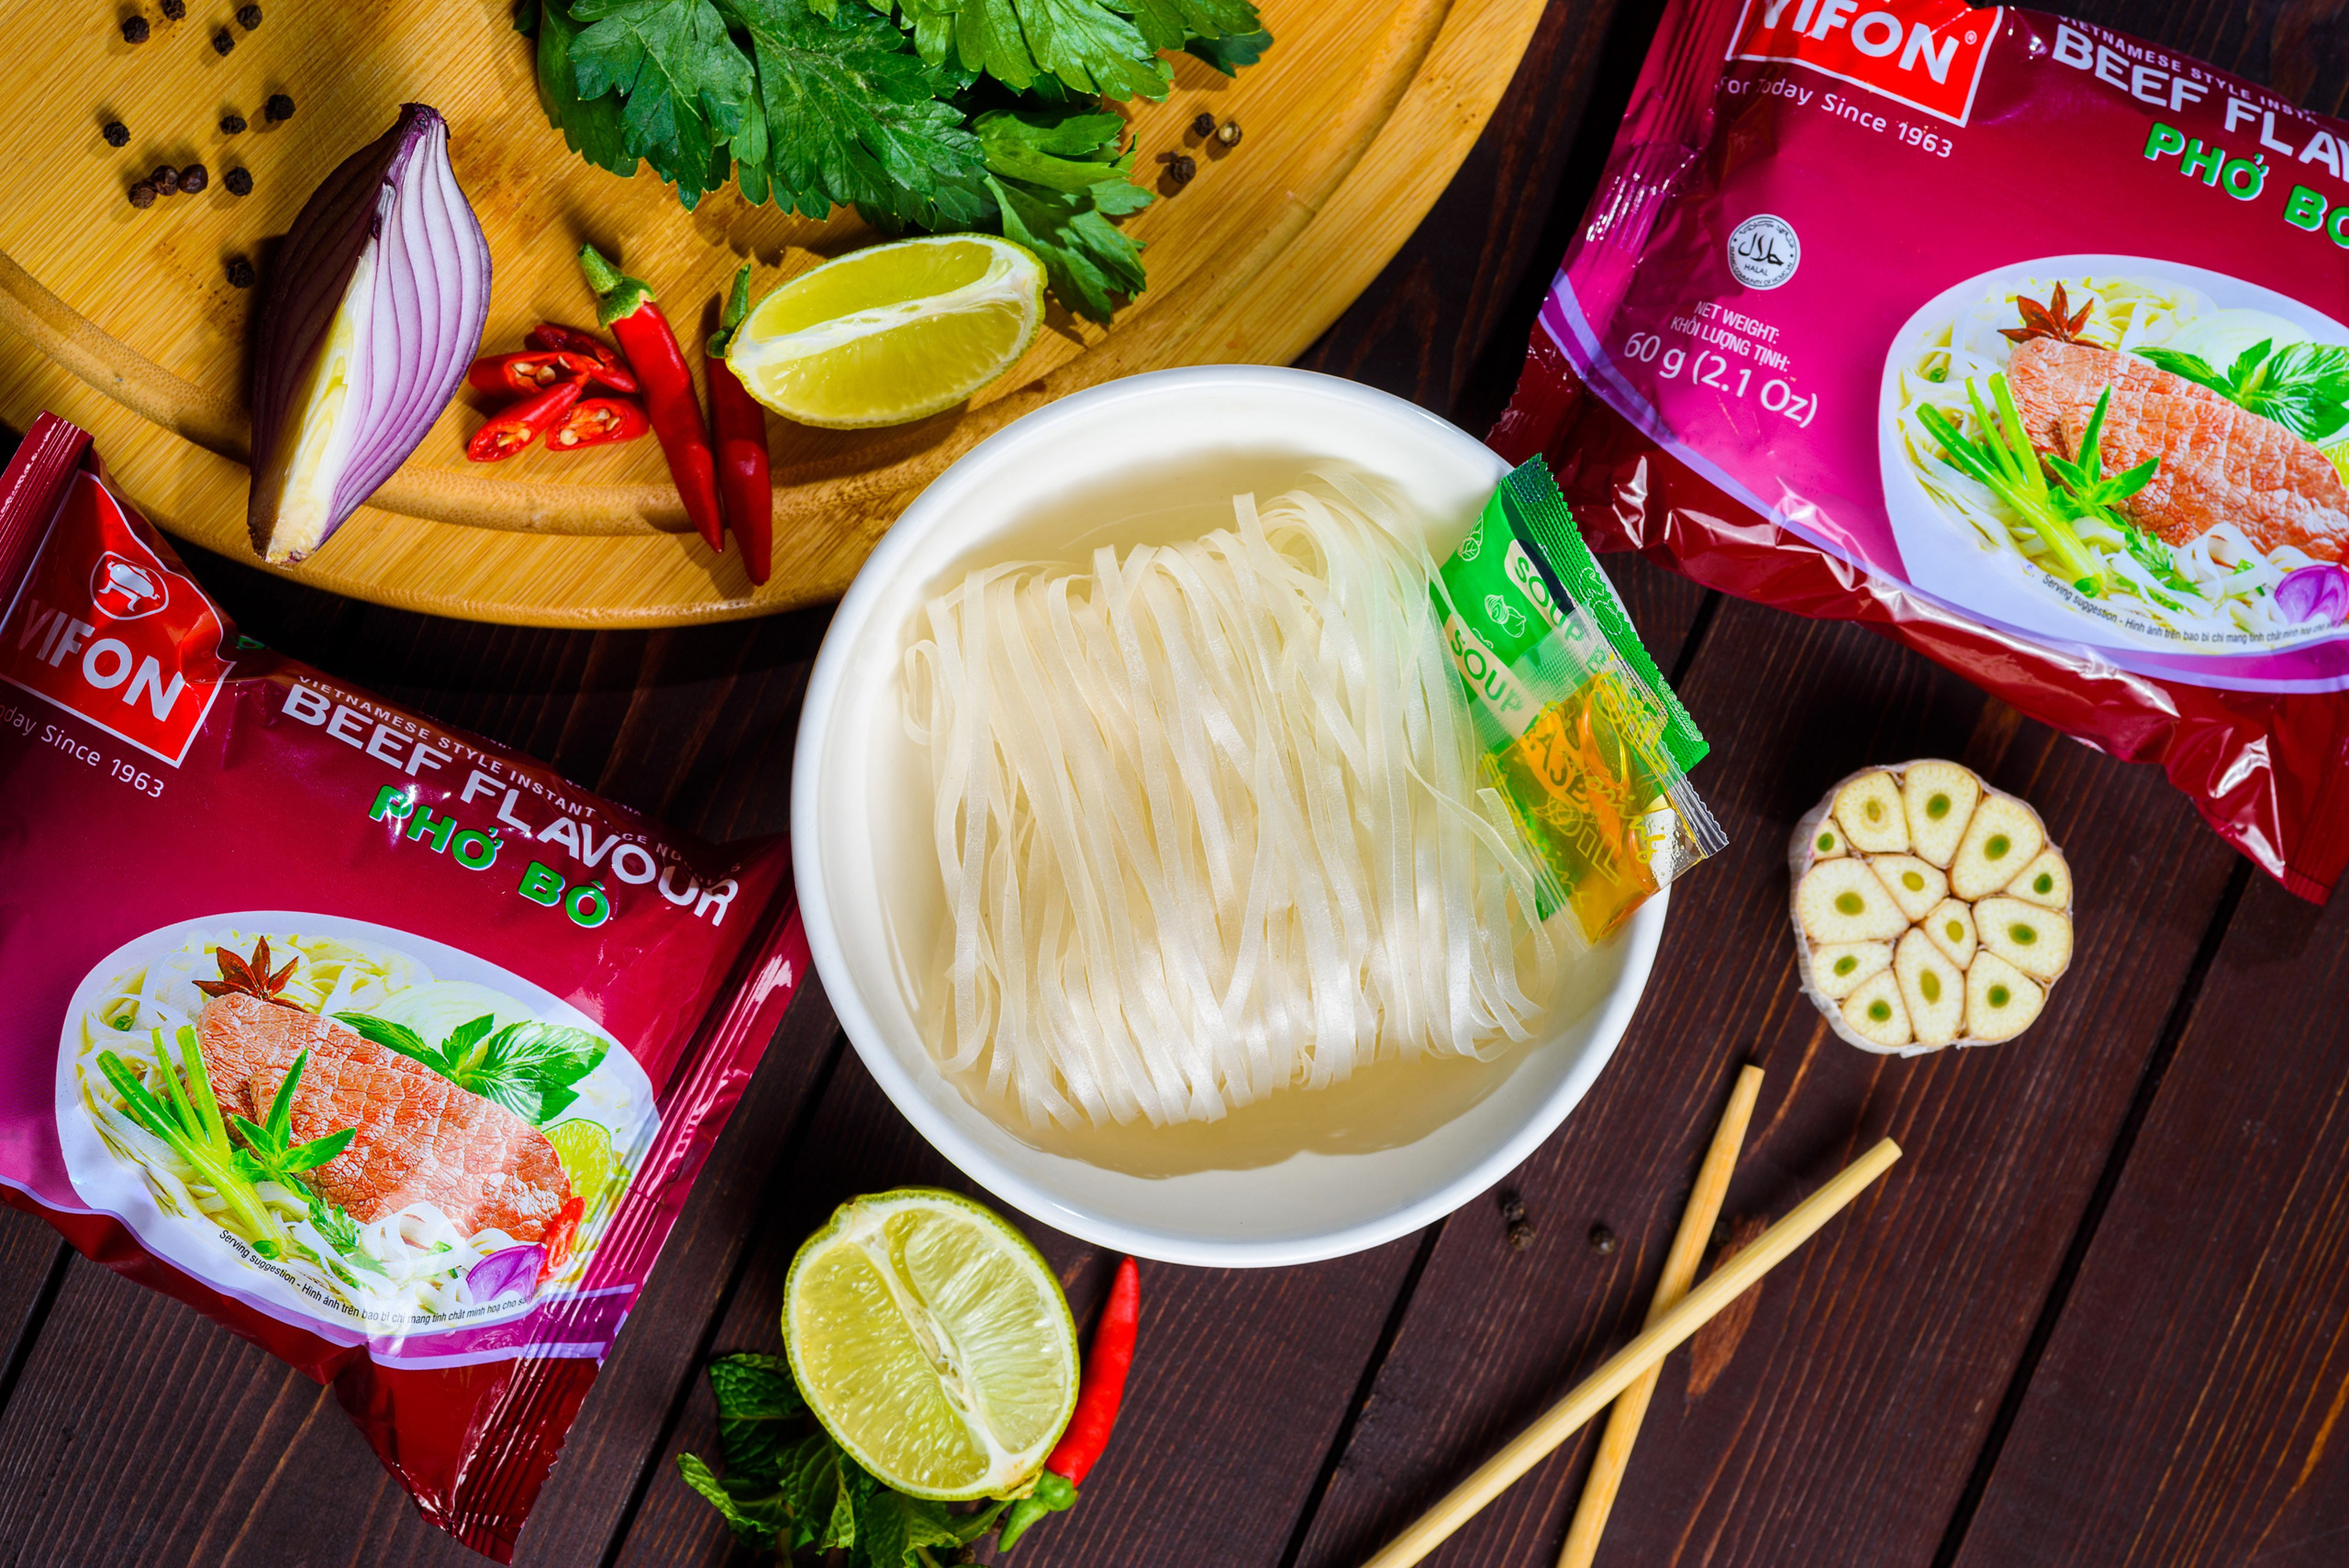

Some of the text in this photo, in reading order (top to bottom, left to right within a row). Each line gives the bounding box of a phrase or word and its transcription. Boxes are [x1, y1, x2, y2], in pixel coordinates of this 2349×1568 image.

[2052, 23, 2209, 112] BEEF
[2059, 16, 2182, 72] VIETNAMESE
[2191, 67, 2252, 100] STYLE
[1820, 93, 1887, 133] Since
[1898, 122, 1954, 158] 1963
[1743, 263, 1769, 277] HALAL
[1694, 301, 1780, 345] NET WEIGHT:
[1623, 331, 1819, 428] 60 g (2.1 Oz)
[1514, 555, 1586, 642] SOUP
[2042, 573, 2074, 602] Serving
[2074, 595, 2118, 624] suggestion
[17, 599, 184, 723] VIFON
[1450, 628, 1525, 712] SOUP
[41, 724, 101, 767] Since
[110, 758, 164, 799] 1963
[299, 675, 430, 740] VIETNAMESE
[438, 736, 503, 774] STYLE
[509, 770, 596, 817] INSTANT
[281, 683, 739, 928] BEEF FLAVOUR
[218, 1229, 251, 1259] Serving
[250, 1253, 296, 1286] suggestion
[362, 1308, 379, 1321] bao
[466, 1306, 486, 1318] minh
[502, 1299, 517, 1310] cho
